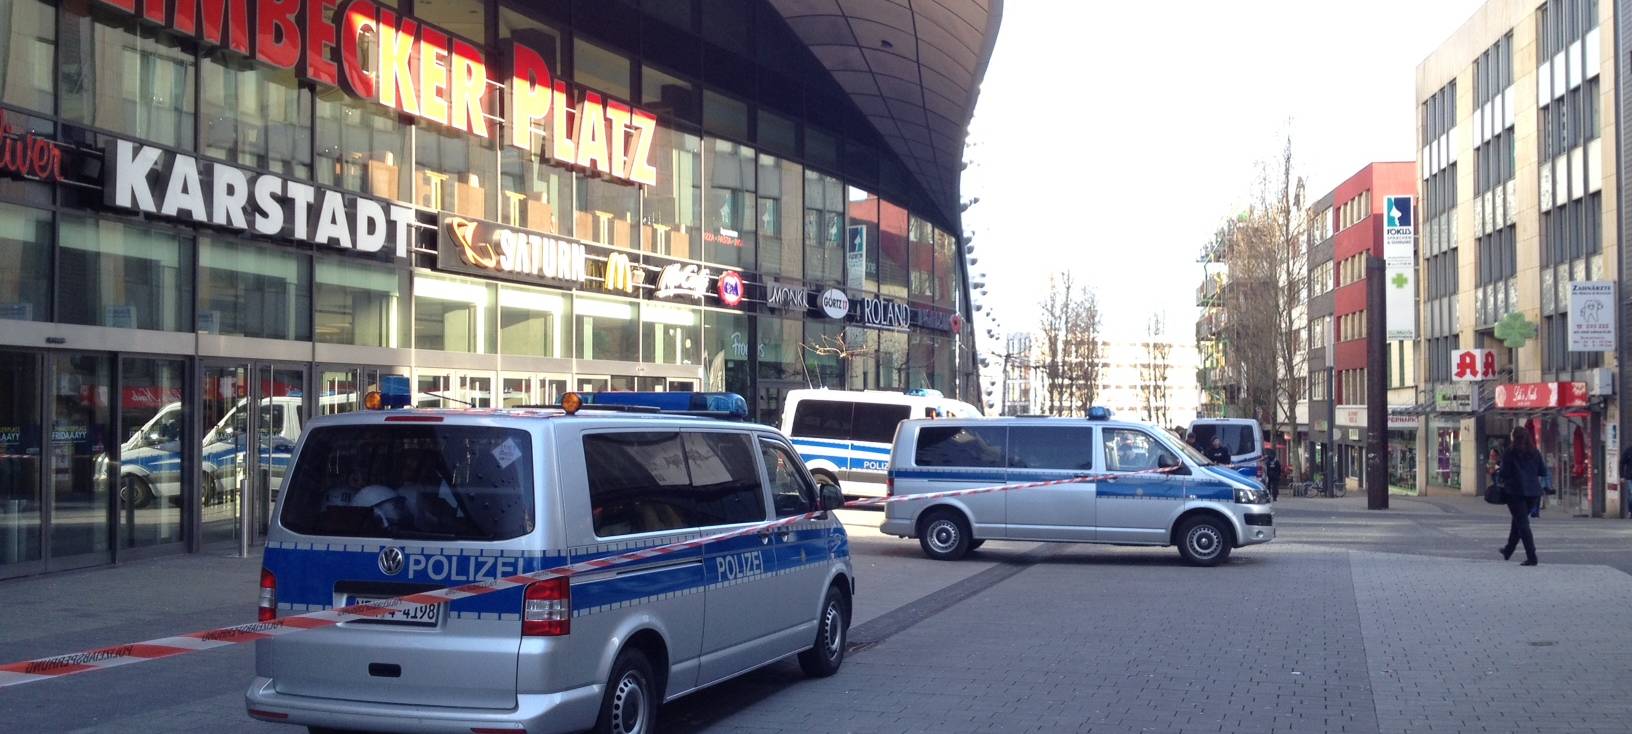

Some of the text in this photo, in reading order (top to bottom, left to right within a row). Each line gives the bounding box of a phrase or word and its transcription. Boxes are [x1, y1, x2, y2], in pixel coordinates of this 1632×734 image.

[100, 0, 657, 187] MBECKER PLATZ
[115, 139, 415, 258] KARSTADT
[499, 229, 586, 282] SATURN
[864, 297, 911, 329] ROLAND
[715, 551, 763, 582] POLIZEI
